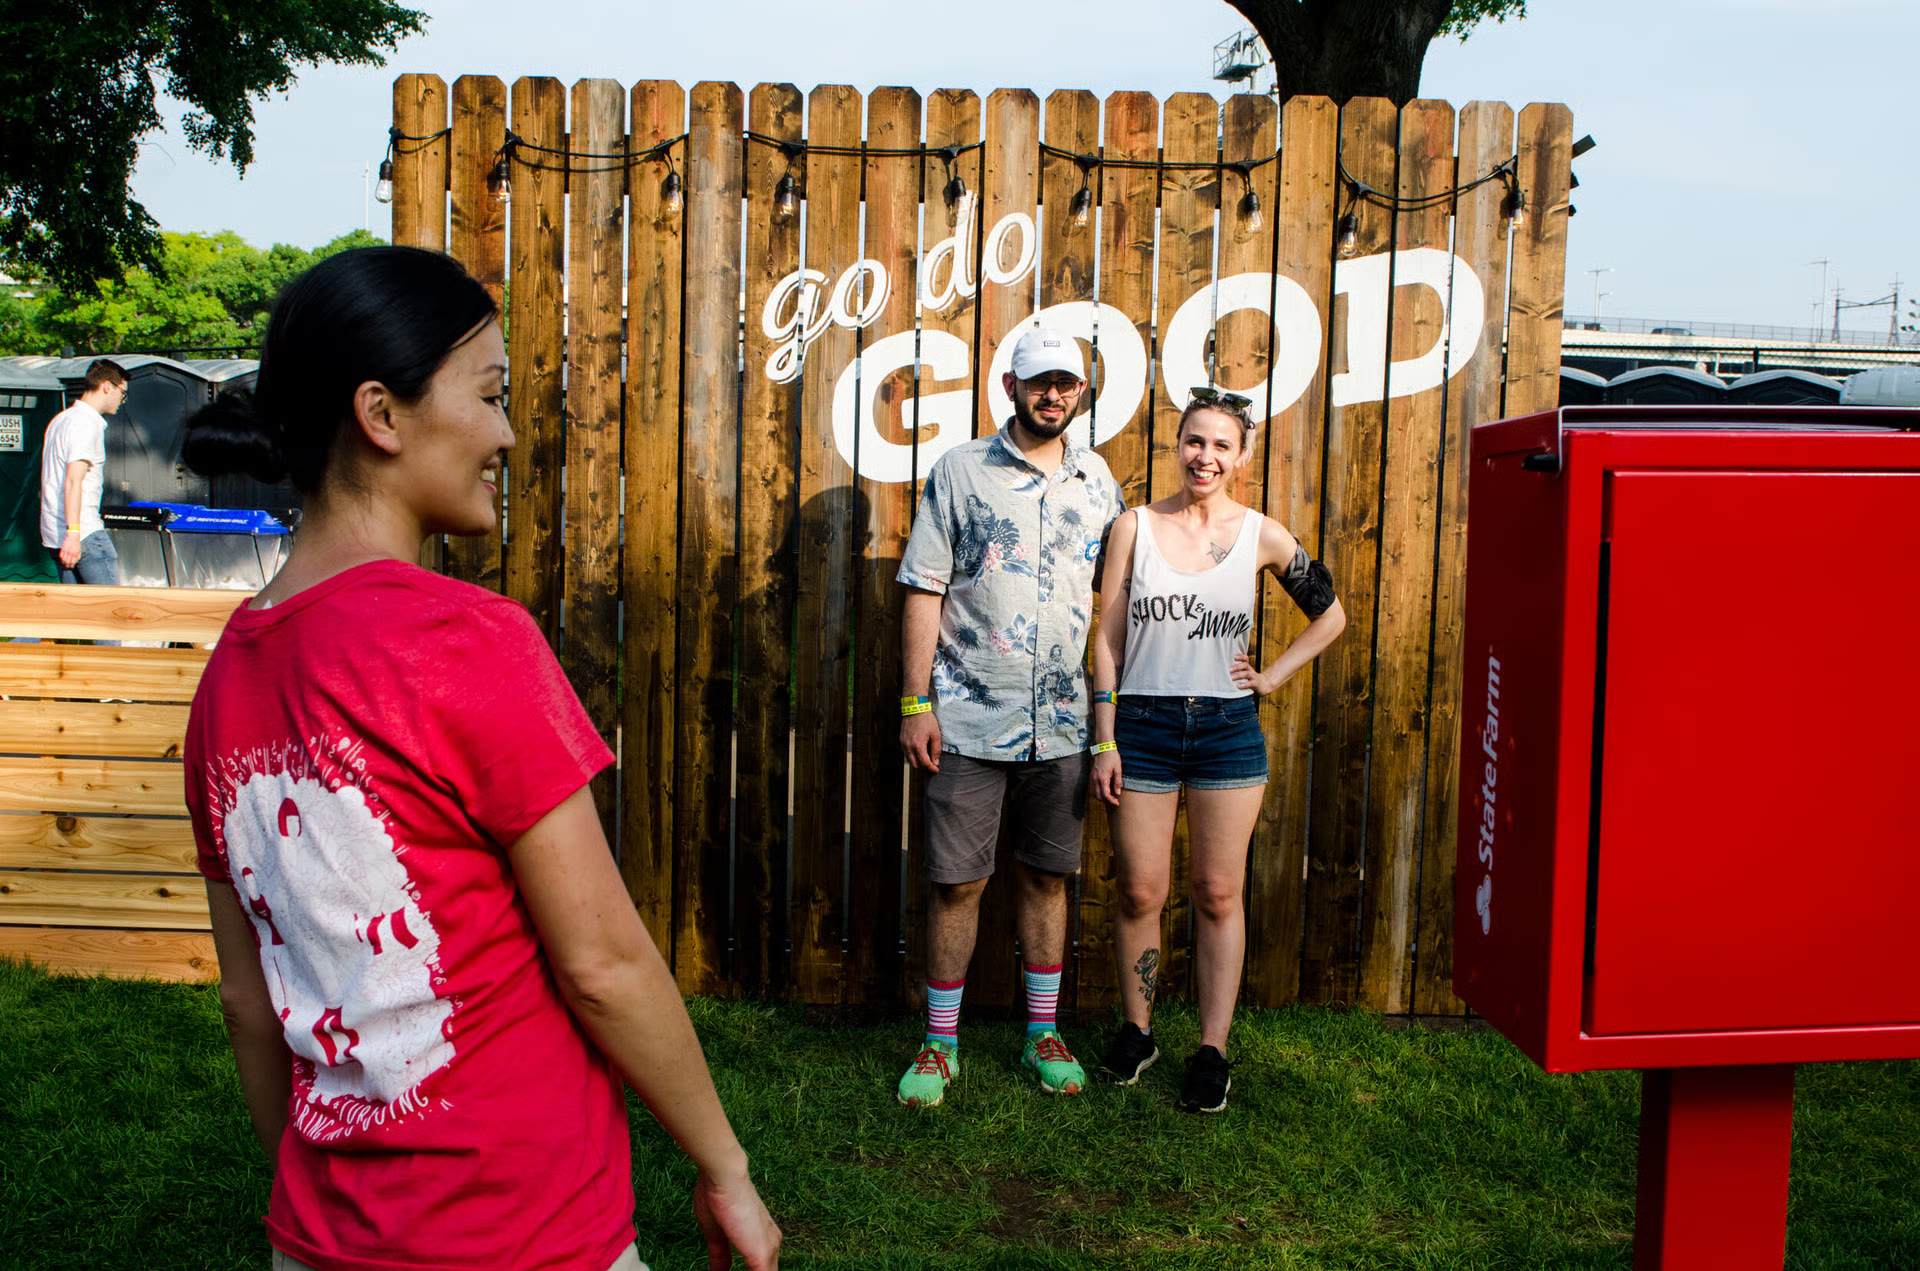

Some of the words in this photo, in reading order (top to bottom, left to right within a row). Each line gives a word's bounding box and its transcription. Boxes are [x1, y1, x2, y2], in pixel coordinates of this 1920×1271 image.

[762, 259, 892, 385] go
[921, 189, 1036, 312] do
[832, 247, 1485, 483] GOOD
[0, 418, 20, 428] USH
[1132, 594, 1198, 628] SHOCK
[1195, 603, 1205, 613] &
